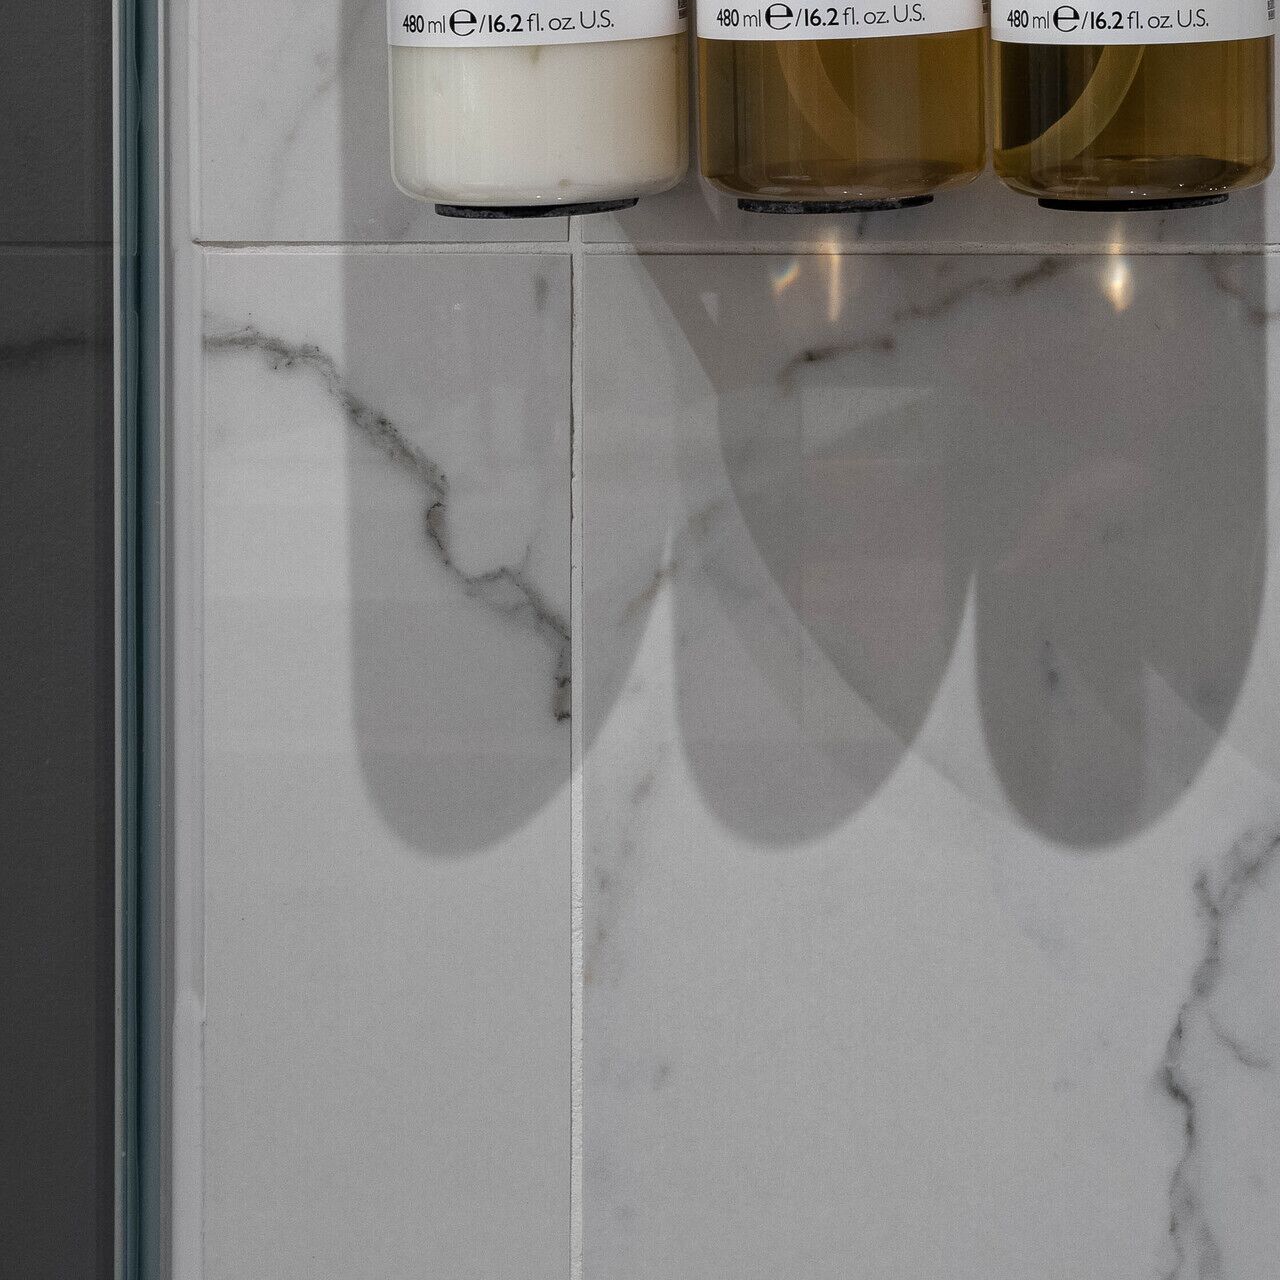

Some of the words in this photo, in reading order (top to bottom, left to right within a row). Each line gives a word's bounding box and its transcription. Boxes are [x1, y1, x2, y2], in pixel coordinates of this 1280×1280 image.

[403, 15, 424, 33] 480
[428, 16, 445, 33] ml
[527, 13, 544, 31] fl.
[548, 18, 575, 31] oz.
[580, 10, 614, 29] U.S.
[717, 9, 739, 27] 480
[743, 9, 761, 27] ml
[843, 7, 859, 25] fl.
[864, 11, 889, 24] oz.
[894, 3, 925, 23] U.S.
[1007, 10, 1029, 28] 480
[1033, 11, 1049, 29] ml
[1127, 11, 1143, 29] fl.
[1148, 16, 1173, 29] oz.
[1177, 9, 1208, 28] U.S.
